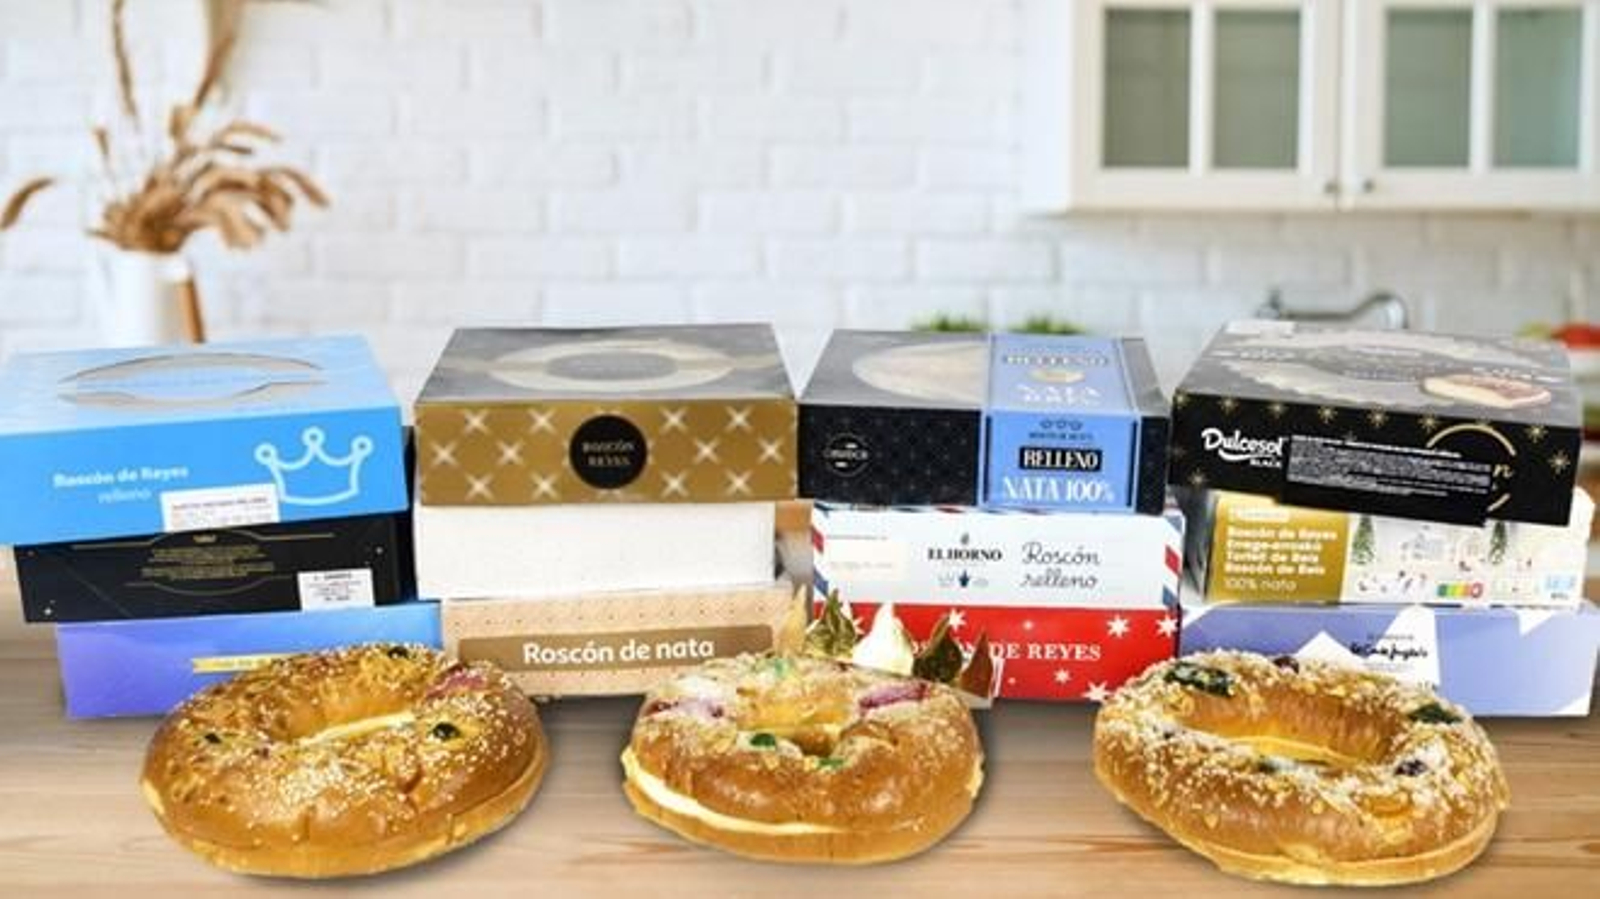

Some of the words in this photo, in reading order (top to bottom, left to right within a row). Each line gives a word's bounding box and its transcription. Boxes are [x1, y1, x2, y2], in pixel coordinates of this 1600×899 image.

[1201, 427, 1283, 460] Dulcesol
[1023, 450, 1098, 469] RELLENO
[117, 467, 139, 482] de
[141, 465, 189, 482] Reyes
[1003, 475, 1060, 500] NATA
[1065, 476, 1114, 502] 100%
[1278, 528, 1296, 539] de
[946, 548, 1003, 562] HORNO
[1021, 541, 1101, 566] Roscón
[1019, 568, 1098, 590] relleno
[523, 641, 615, 664] Roscón
[619, 640, 651, 662] de
[655, 641, 715, 659] nata
[989, 643, 1021, 659] DE
[1027, 643, 1101, 662] REYES
